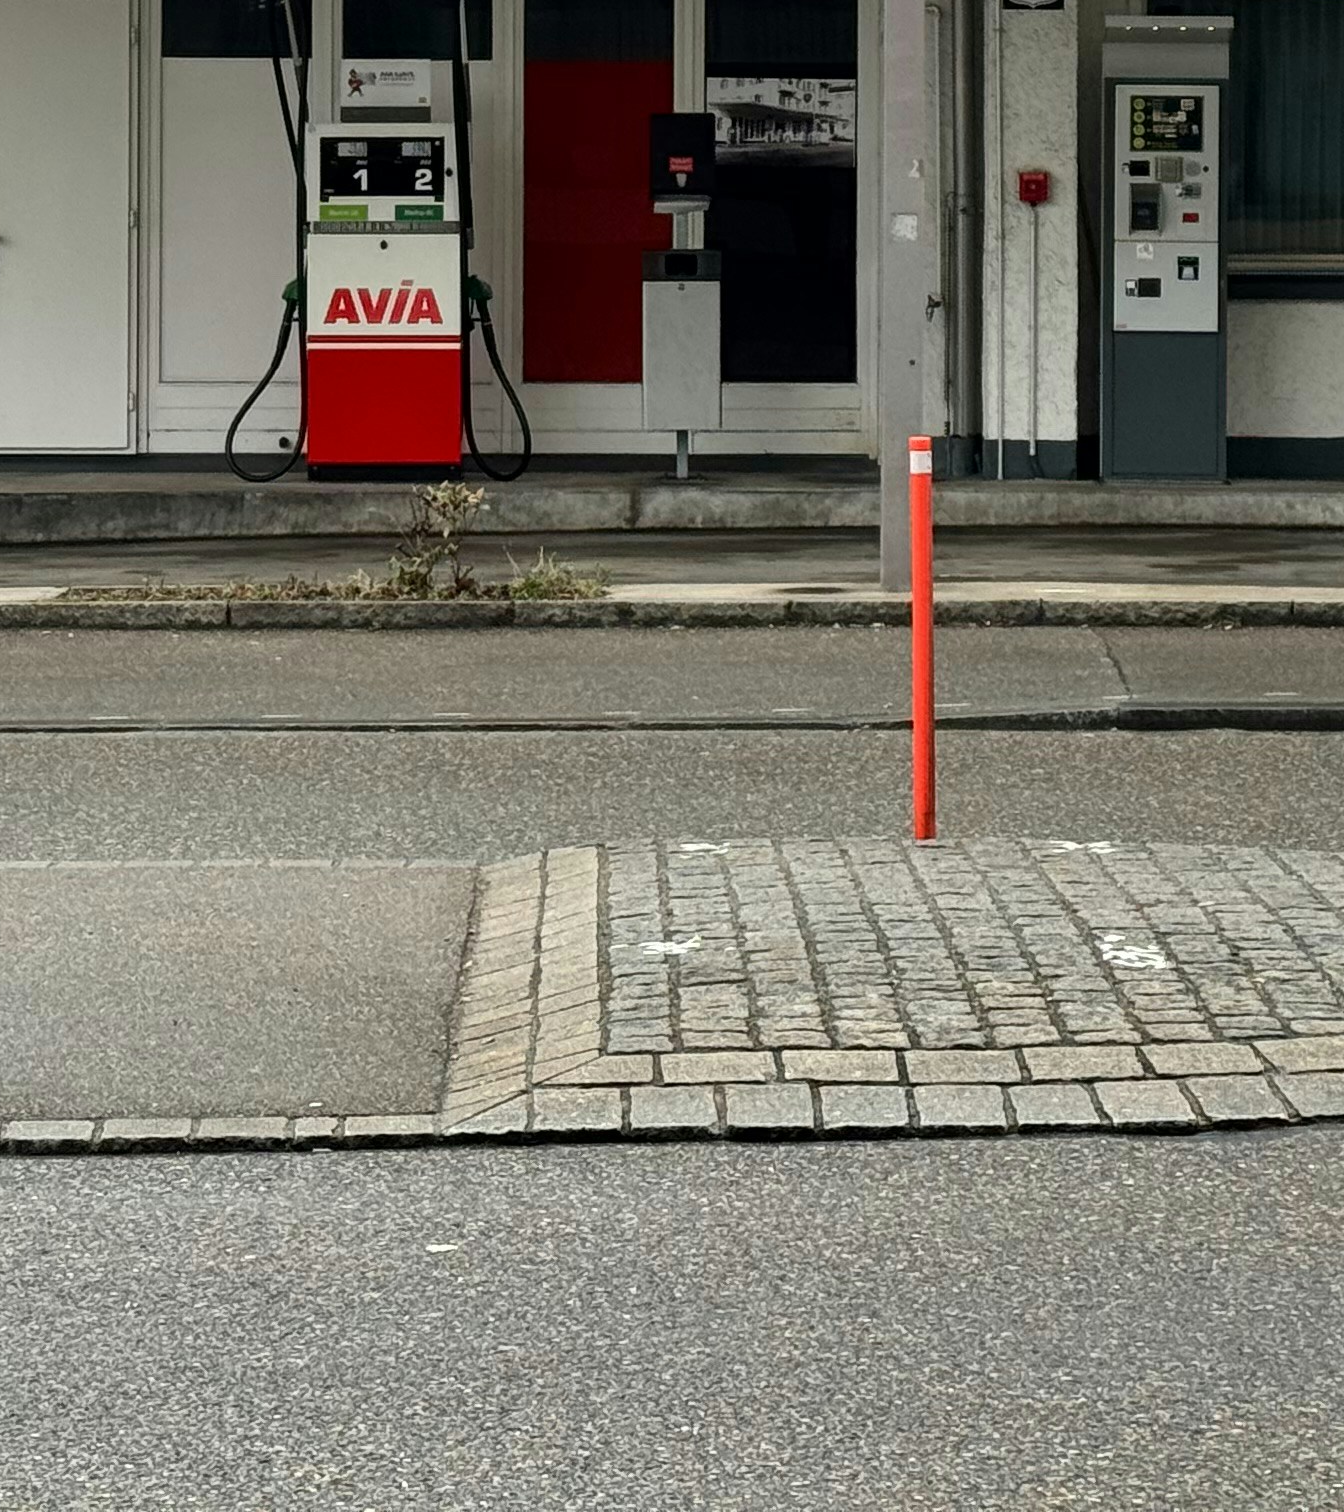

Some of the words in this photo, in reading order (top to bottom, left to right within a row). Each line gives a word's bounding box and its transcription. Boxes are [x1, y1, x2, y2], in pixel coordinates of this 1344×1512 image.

[353, 169, 368, 191] 1
[414, 168, 433, 191] 2
[323, 279, 443, 325] AVIA
